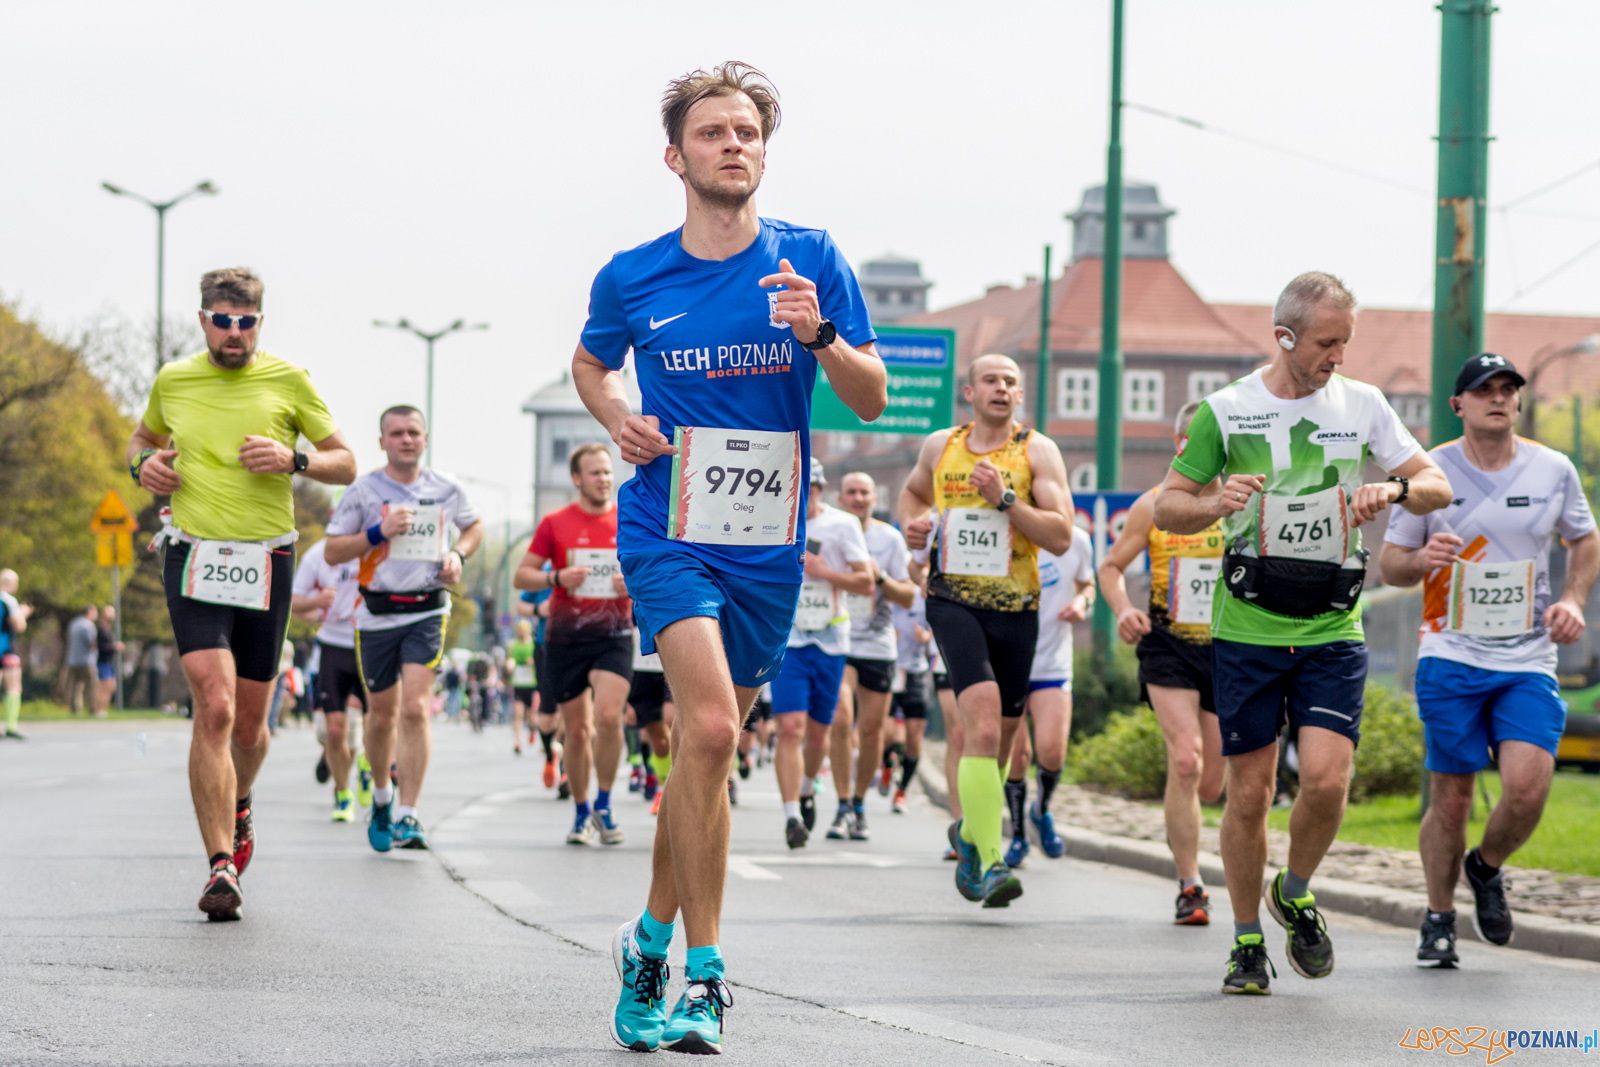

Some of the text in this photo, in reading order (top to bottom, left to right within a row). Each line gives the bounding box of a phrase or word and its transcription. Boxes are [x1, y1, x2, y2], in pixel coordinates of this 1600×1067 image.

[661, 339, 792, 371] LECH POZNAŃ
[706, 365, 791, 379] MOCNI RAZEM
[1228, 412, 1280, 422] BOHAR PALETY
[1238, 422, 1271, 430] RUNNERS
[705, 465, 782, 497] 9794
[944, 473, 967, 482] KLUB
[733, 502, 754, 513] Oleg
[401, 523, 436, 537] 349
[1278, 516, 1332, 543] 4761
[957, 529, 998, 548] 5141
[1293, 545, 1322, 554] MARCIN
[202, 563, 259, 585] 2500
[1469, 586, 1525, 605] 12223
